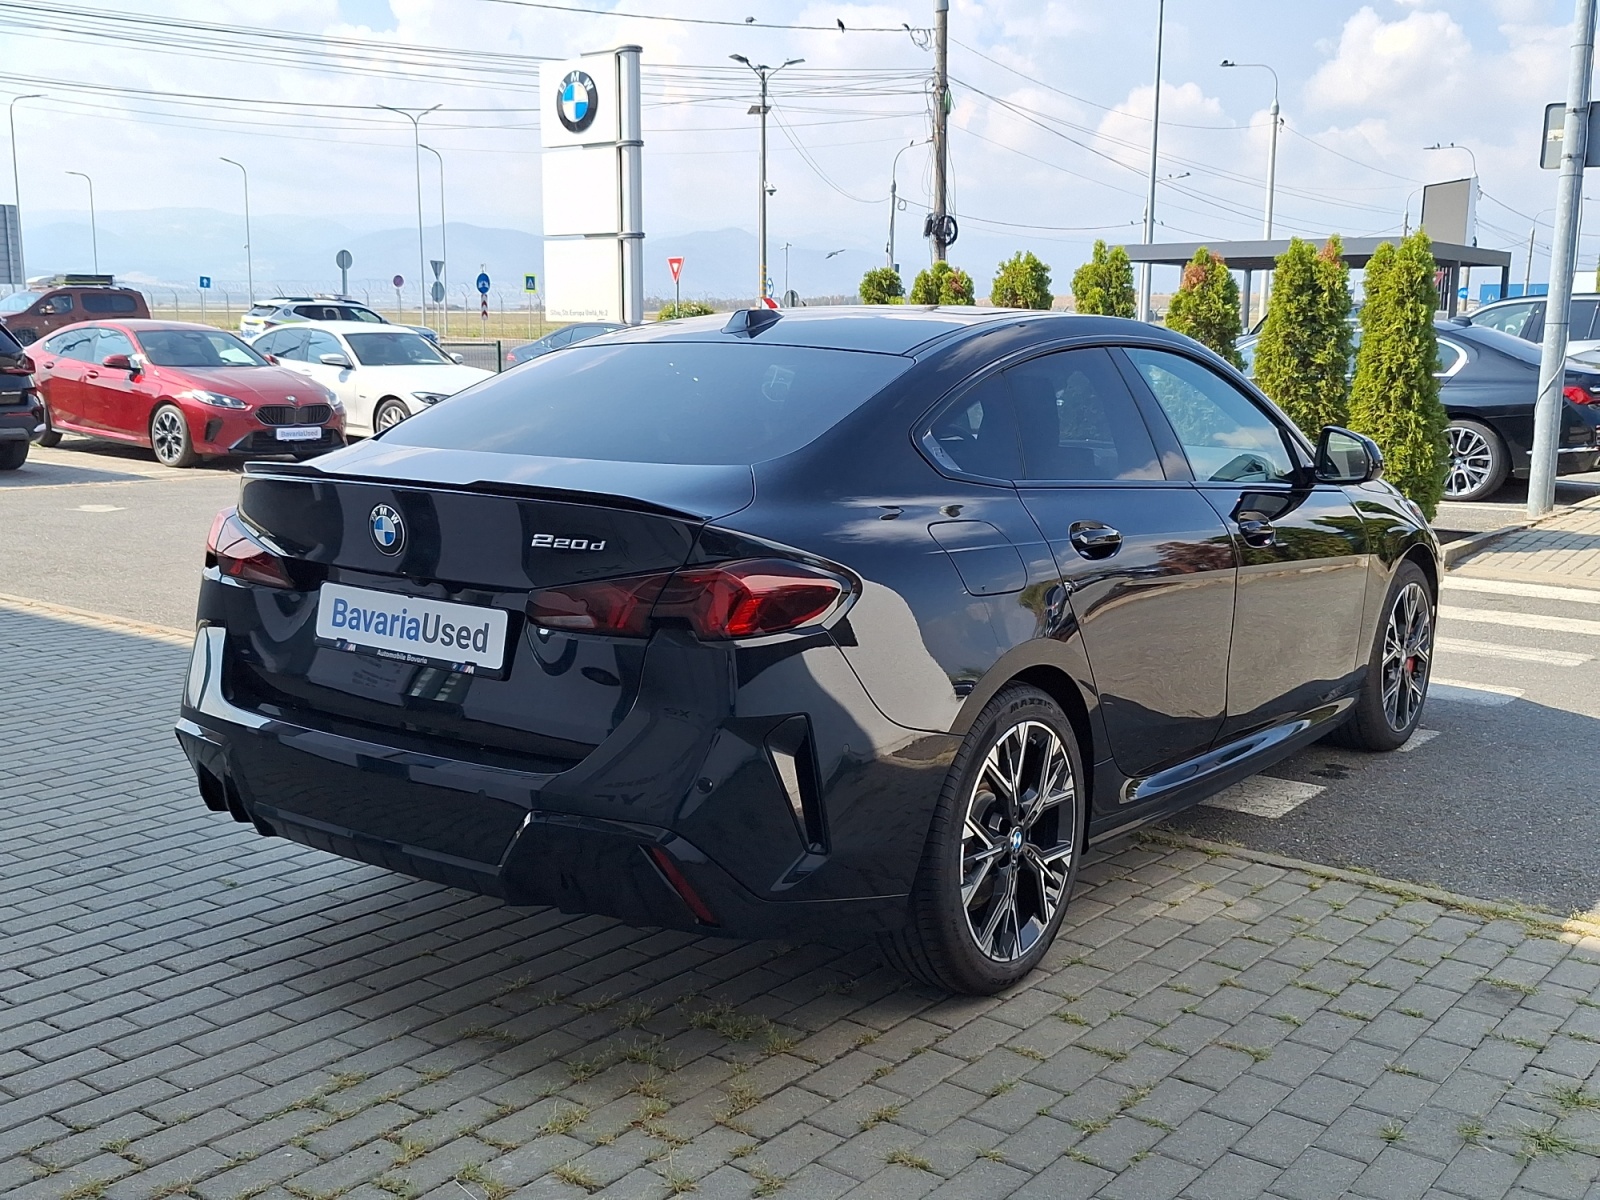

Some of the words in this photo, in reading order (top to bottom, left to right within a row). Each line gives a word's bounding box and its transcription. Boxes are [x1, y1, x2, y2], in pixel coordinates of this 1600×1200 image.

[559, 71, 594, 94] BMW
[371, 507, 400, 525] BMW
[331, 597, 490, 654] BavariaUsed
[377, 649, 406, 661] Automobile
[406, 654, 428, 665] Bavaria
[1010, 697, 1053, 714] MAXXIS
